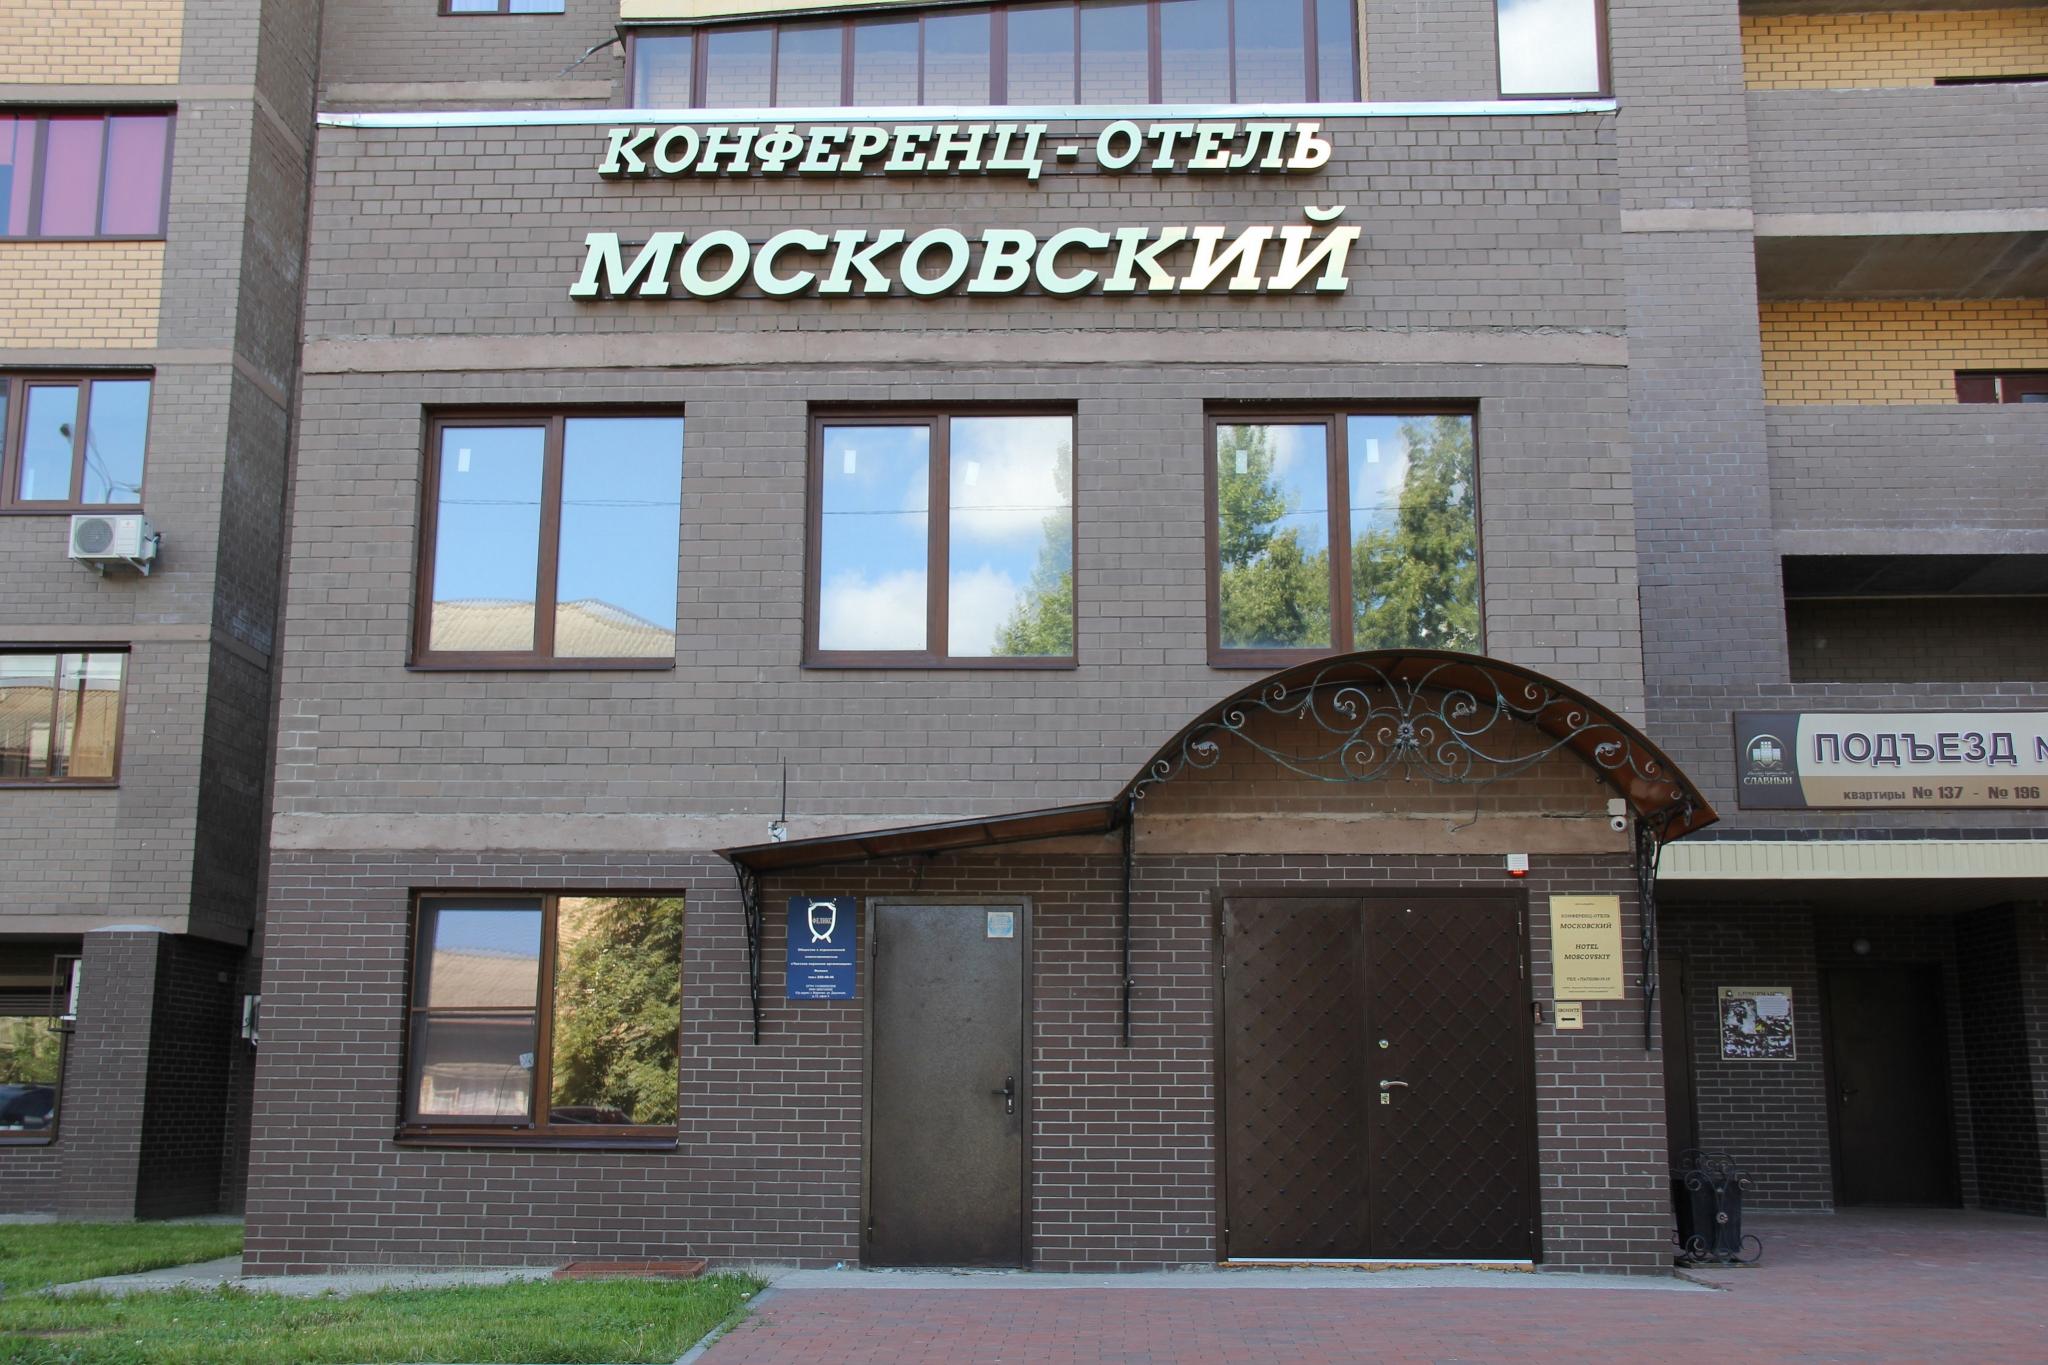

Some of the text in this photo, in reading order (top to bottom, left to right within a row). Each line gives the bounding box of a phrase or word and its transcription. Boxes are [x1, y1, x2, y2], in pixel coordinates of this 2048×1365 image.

[570, 205, 1362, 300] МОСКОВСКИЙ
[1814, 731, 2019, 766] ПОДЪЕЗД
[1843, 790, 1906, 801] квартиры
[1912, 786, 1933, 799] №
[1938, 786, 1964, 800] 137
[1987, 786, 2009, 799] №
[2013, 786, 2041, 800] 196
